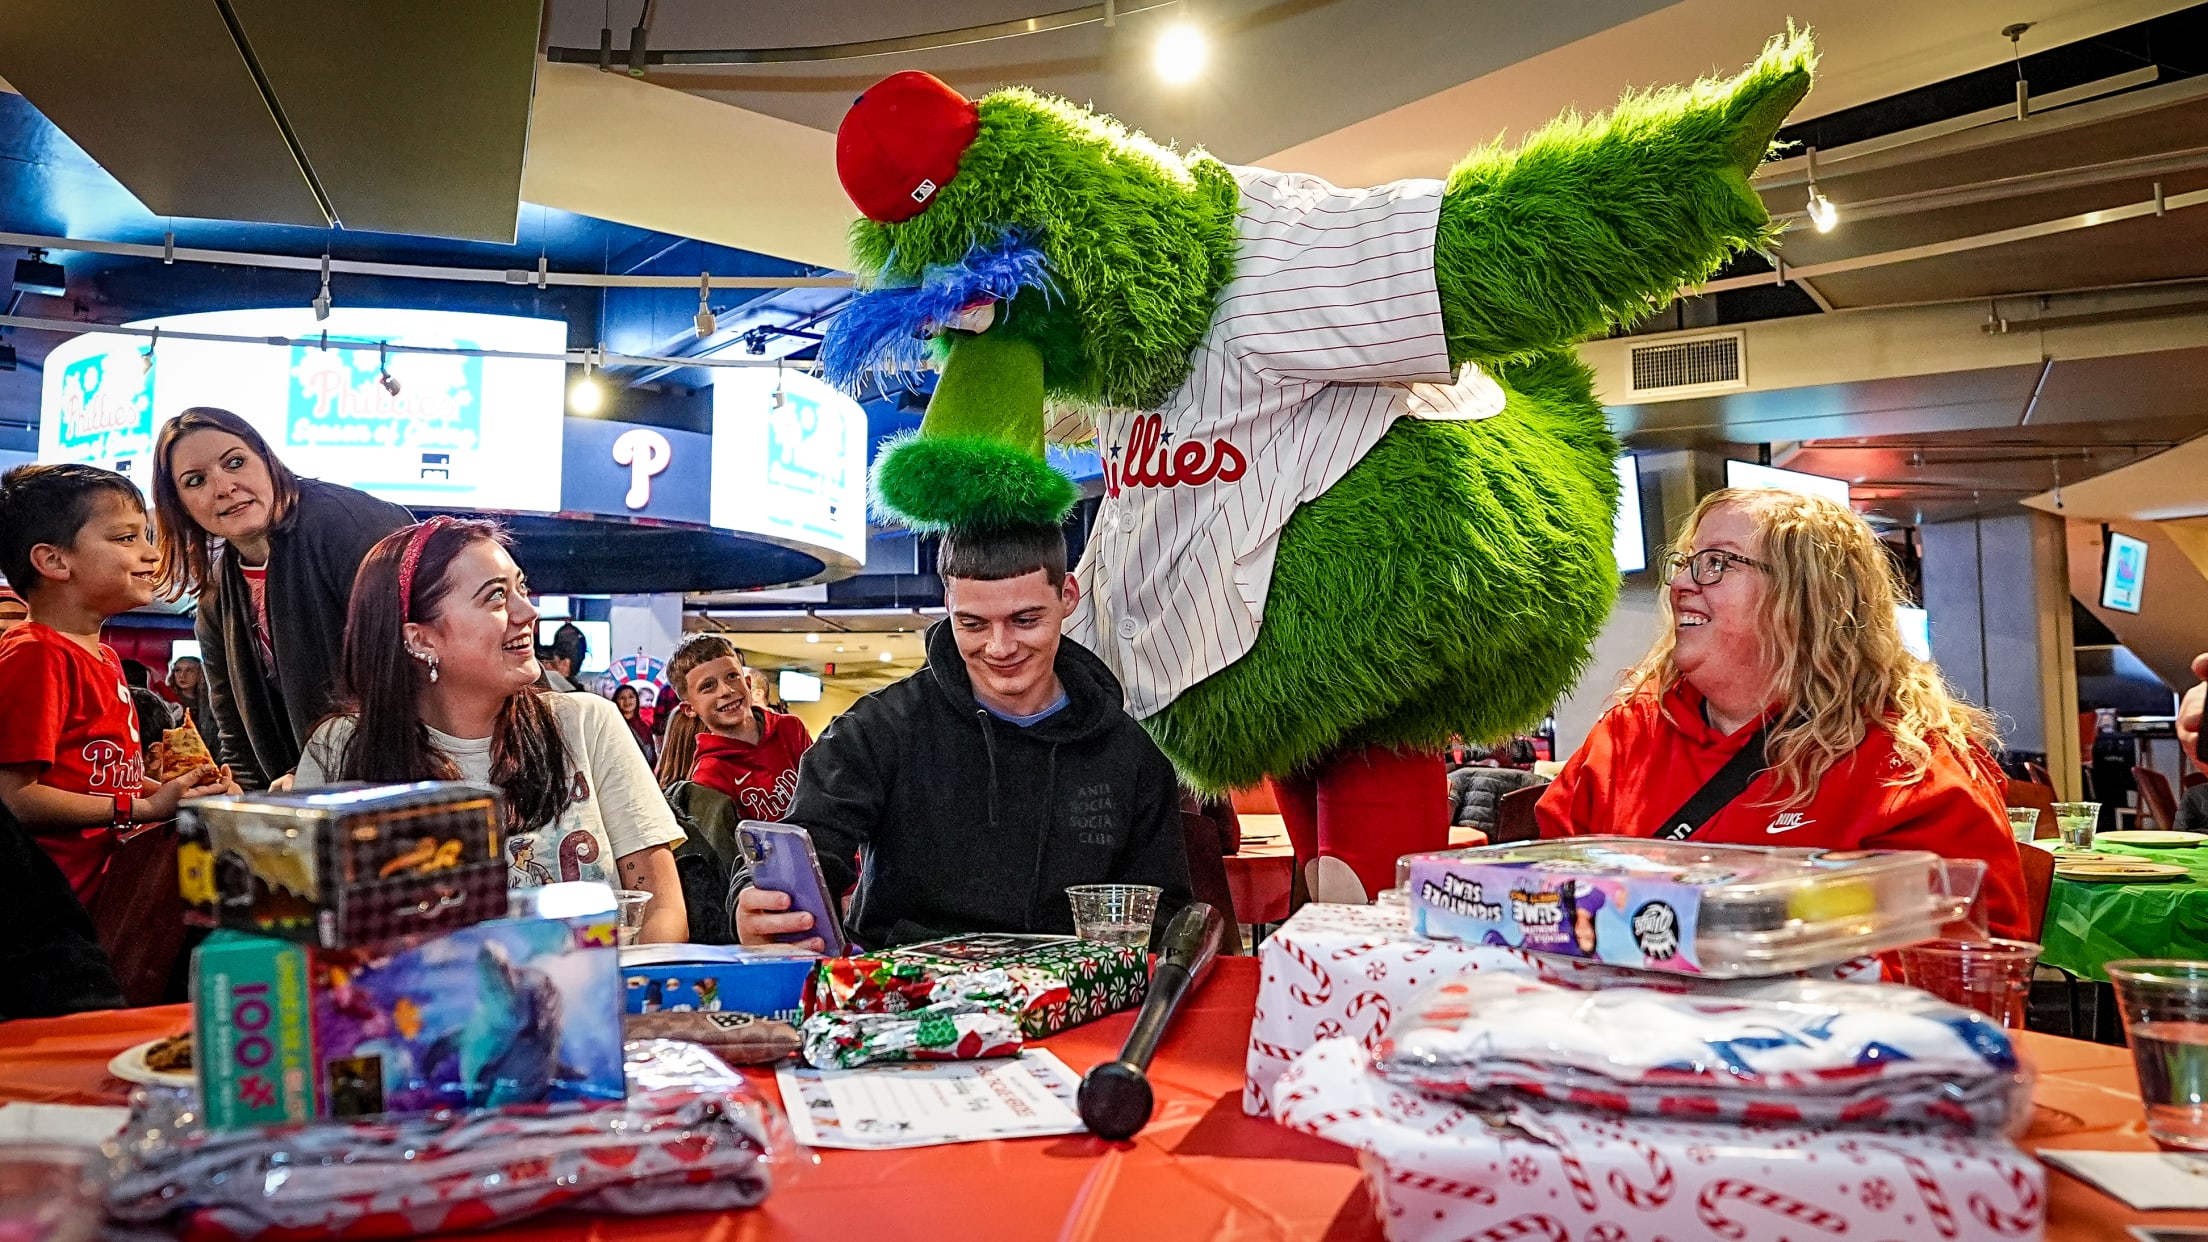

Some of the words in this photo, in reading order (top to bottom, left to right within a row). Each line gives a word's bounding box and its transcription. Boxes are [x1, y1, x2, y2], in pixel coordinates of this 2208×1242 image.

[612, 428, 672, 511] P
[1101, 413, 1247, 499] illies
[741, 768, 799, 821] Phill
[1070, 798, 1116, 813] SOCIA
[1070, 814, 1115, 829] SOCIA
[1774, 812, 1804, 826] NIKE
[1421, 880, 1503, 921] SIGNATURE
[232, 982, 274, 1069] 100
